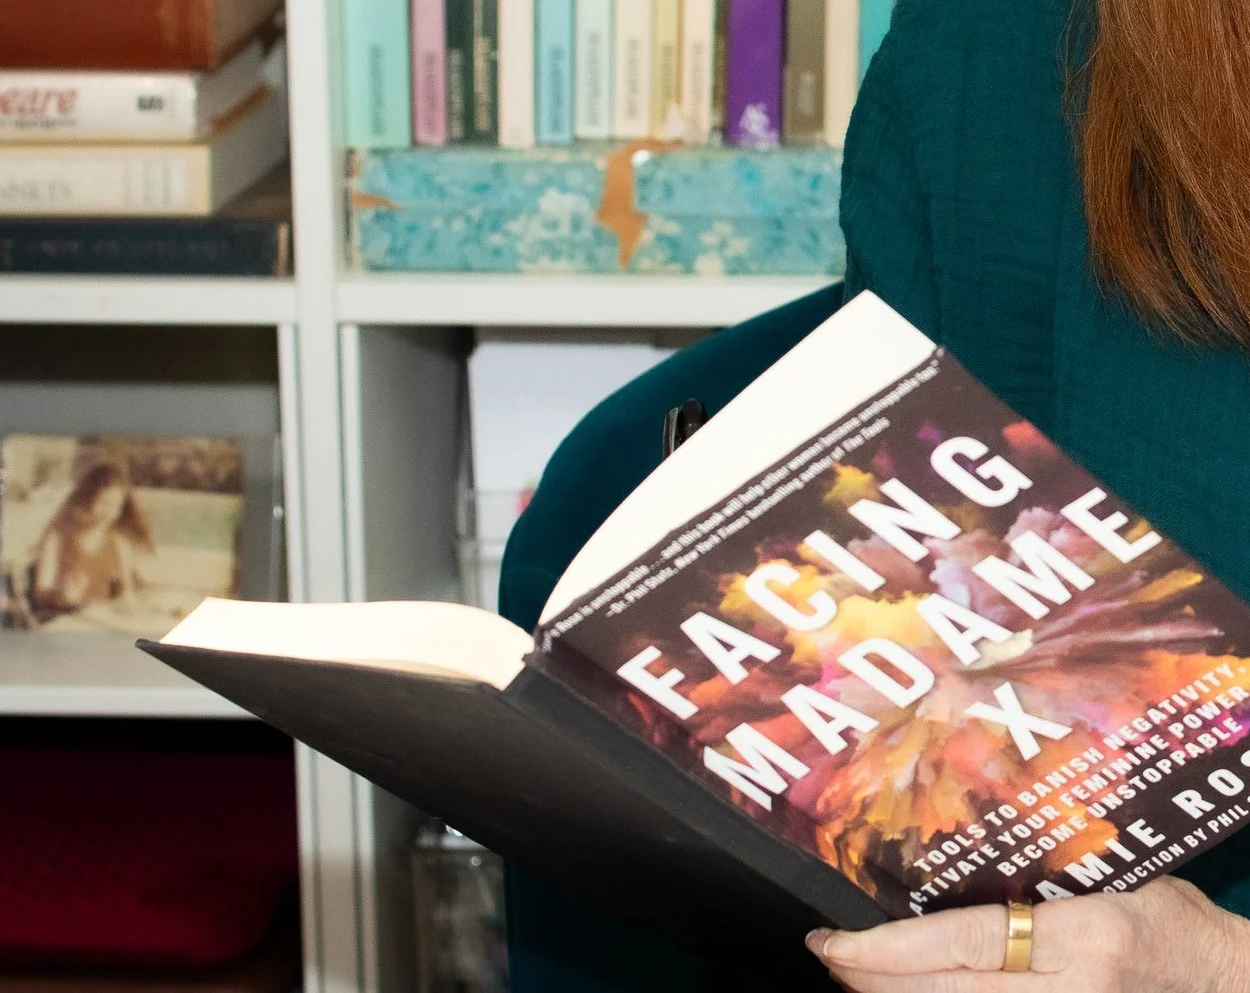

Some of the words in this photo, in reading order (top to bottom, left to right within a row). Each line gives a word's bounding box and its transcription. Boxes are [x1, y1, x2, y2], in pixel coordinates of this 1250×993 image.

[554, 612, 584, 634] Rose
[579, 605, 595, 617] is
[590, 565, 650, 610] unstoppable
[660, 540, 683, 559] and
[676, 528, 703, 547] this
[696, 512, 726, 534] book
[721, 497, 745, 517] will
[737, 484, 765, 505] help
[760, 466, 791, 489] other
[786, 441, 825, 471] women
[818, 416, 862, 448] become
[857, 377, 921, 423] unstoppable
[616, 436, 1034, 720] FACING
[624, 583, 650, 604] Phil
[674, 549, 700, 570] New
[694, 534, 723, 554] York
[717, 514, 751, 540] Times
[745, 477, 805, 520] bestselling
[799, 456, 834, 483] author
[830, 446, 846, 461] of
[841, 434, 866, 453] The
[859, 416, 891, 440] Tools
[703, 487, 1163, 812] MADAME
[965, 681, 1073, 761] X
[909, 843, 1000, 917] ACTIVATE
[997, 804, 1061, 847] YOUR
[1058, 734, 1170, 808] FEMININE
[913, 823, 987, 873] TOOLS
[984, 804, 1018, 827] TO
[1016, 747, 1105, 807] BANISH
[1102, 661, 1247, 751] NEGATIVITY,
[996, 814, 1088, 877] BECOME
[1086, 716, 1244, 819] UNSTOPPABLE
[1035, 818, 1166, 901] AMIE
[1103, 843, 1185, 894] ODUCTION
[1183, 827, 1208, 848] BY
[1207, 803, 1249, 834] PHIL
